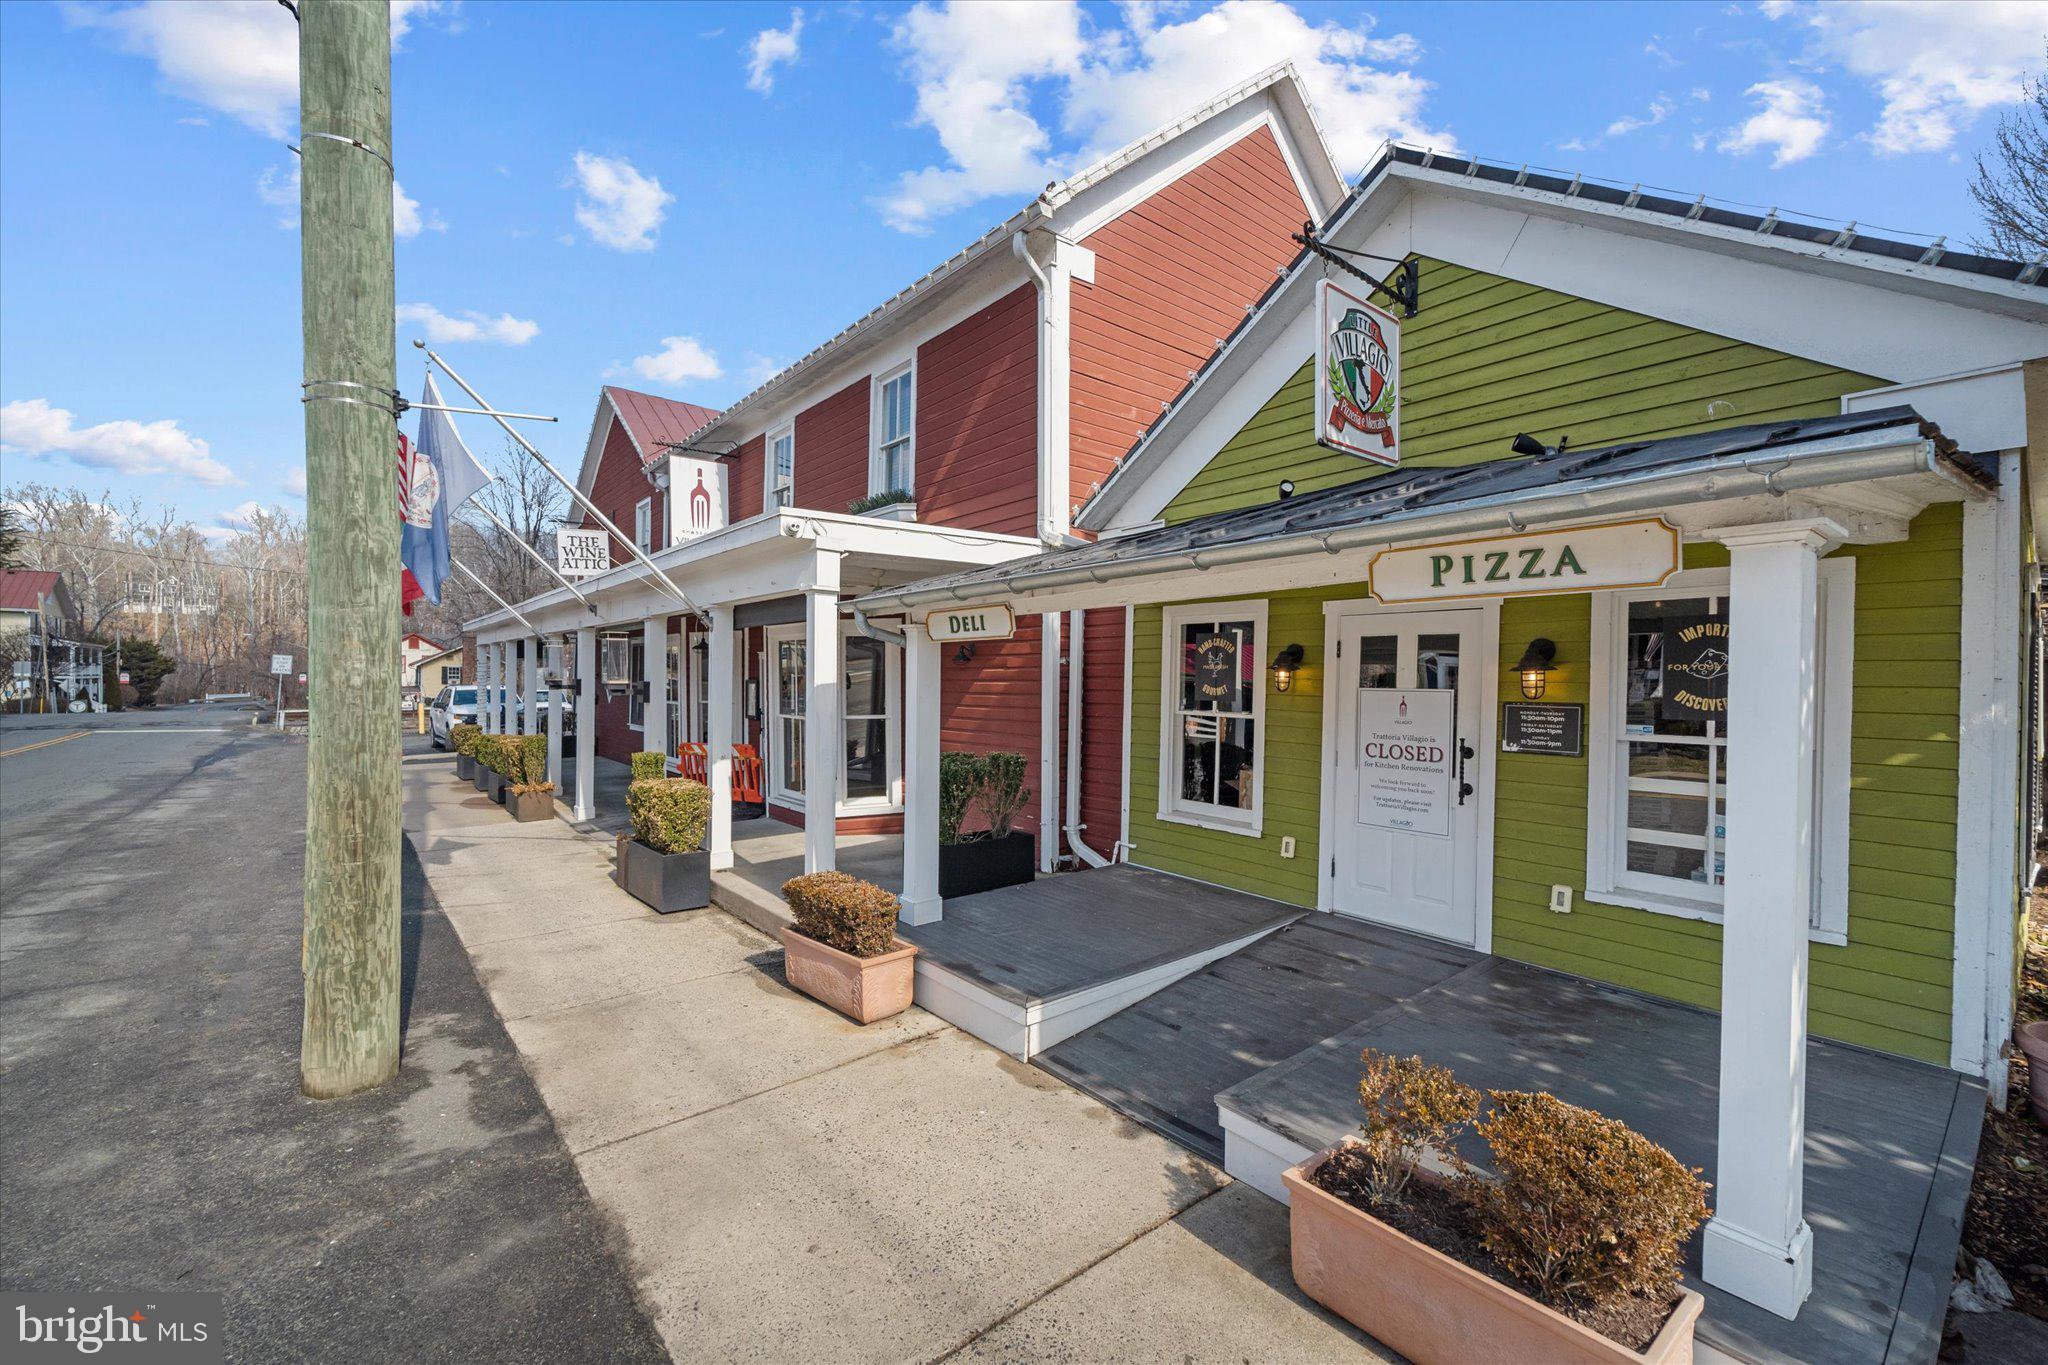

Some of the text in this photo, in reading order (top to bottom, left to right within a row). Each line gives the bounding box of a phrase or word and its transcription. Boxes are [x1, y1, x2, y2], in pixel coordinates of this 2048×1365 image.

[1348, 314, 1376, 338] LITTLE
[1335, 332, 1388, 376] VILLAGIO
[1340, 400, 1360, 425] Pizzeria
[567, 536, 600, 548] THE
[561, 546, 606, 558] WINE
[562, 558, 608, 570] ATTIC
[1430, 544, 1587, 587] PIZZA
[948, 614, 986, 634] DELI
[1678, 624, 1729, 642] IMPORT
[1198, 638, 1235, 654] HAND-CRAFTED
[1202, 684, 1228, 696] GOURMET
[1402, 734, 1428, 743] Villagio
[1365, 742, 1444, 762] CLOSED
[1401, 764, 1444, 774] Renovations
